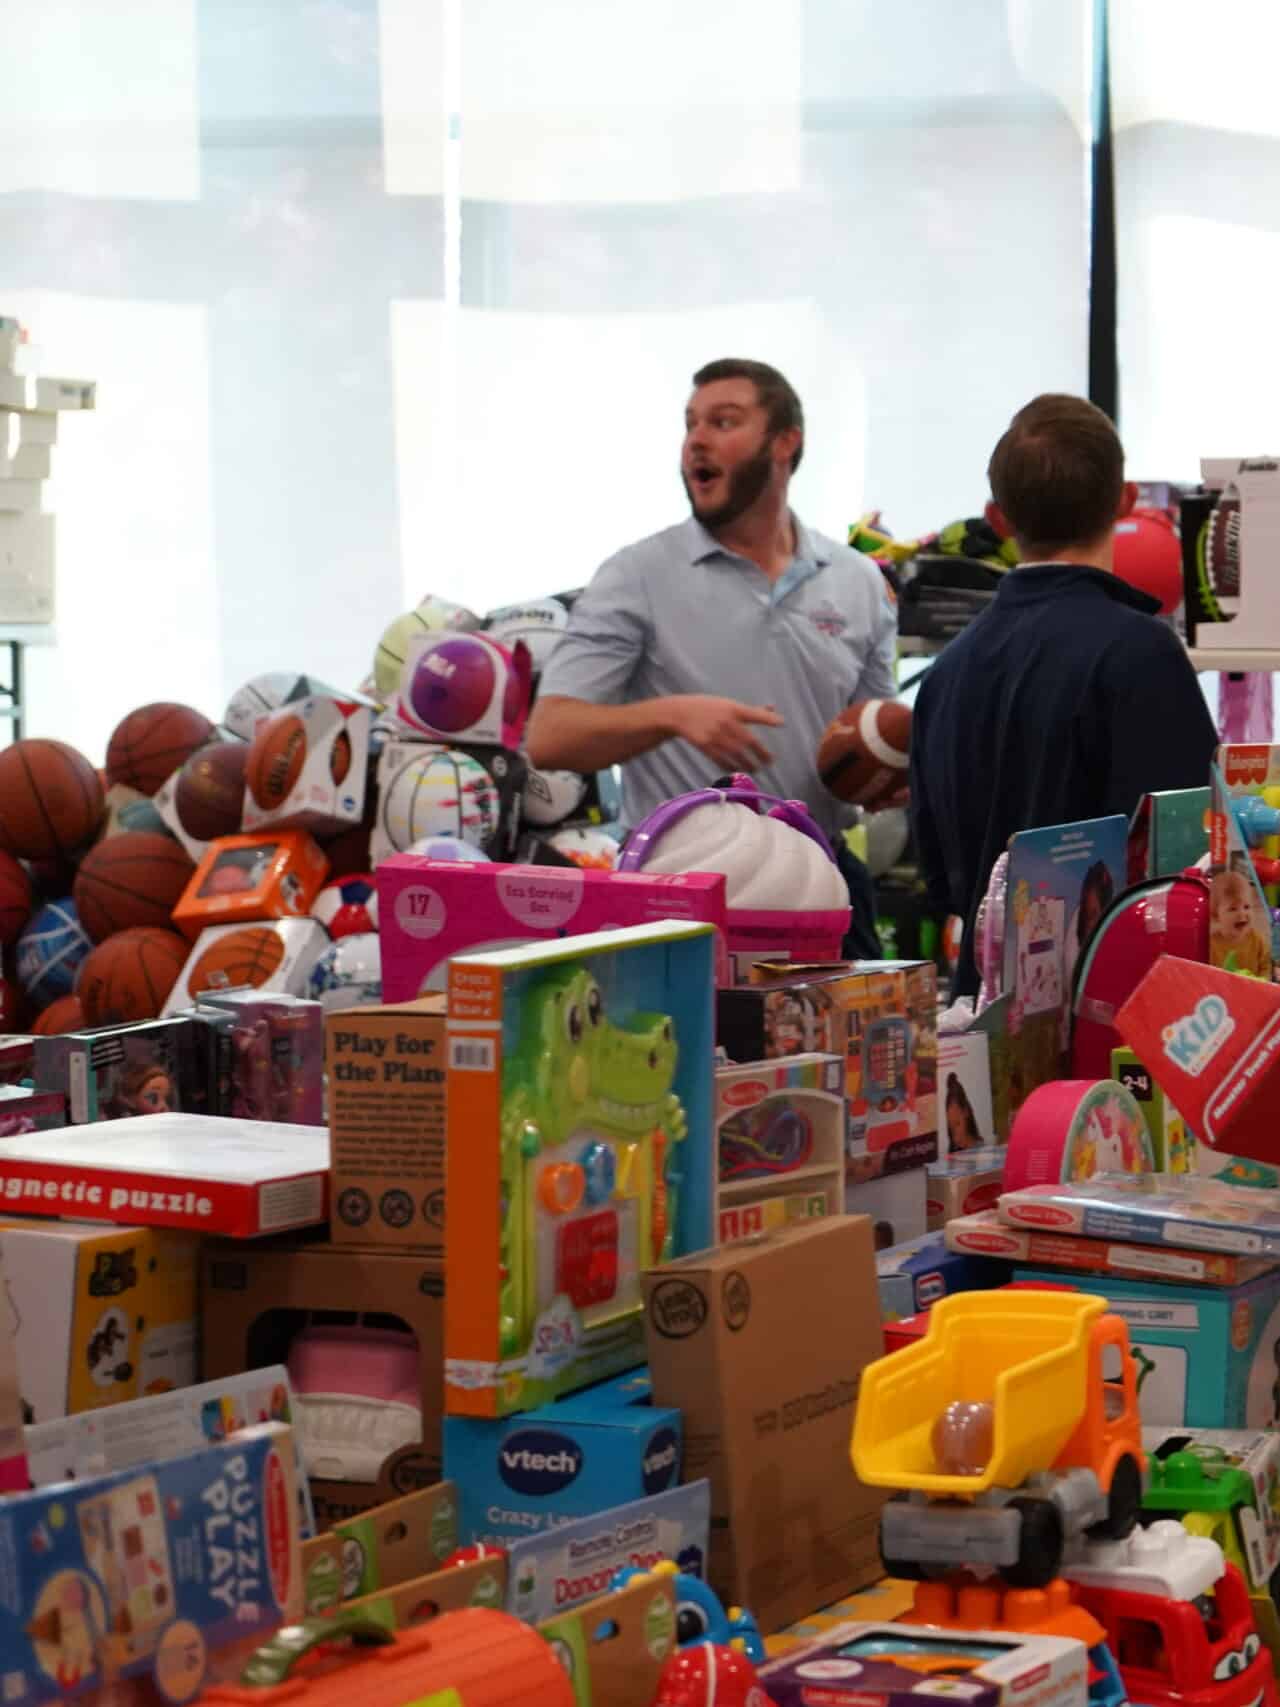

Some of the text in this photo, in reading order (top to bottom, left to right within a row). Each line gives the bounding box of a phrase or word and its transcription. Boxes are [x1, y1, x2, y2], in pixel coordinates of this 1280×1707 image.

[407, 893, 430, 916] 17
[333, 1031, 436, 1057] Play for
[1167, 997, 1226, 1068] KID
[334, 1061, 445, 1083] the Plan
[1122, 1074, 1149, 1092] 2-4
[0, 1175, 213, 1216] gnetic puzzle
[503, 1450, 576, 1473] vtech
[486, 1506, 542, 1529] Crazy
[203, 1478, 235, 1609] PLAY
[225, 1454, 260, 1623] PUZZLE
